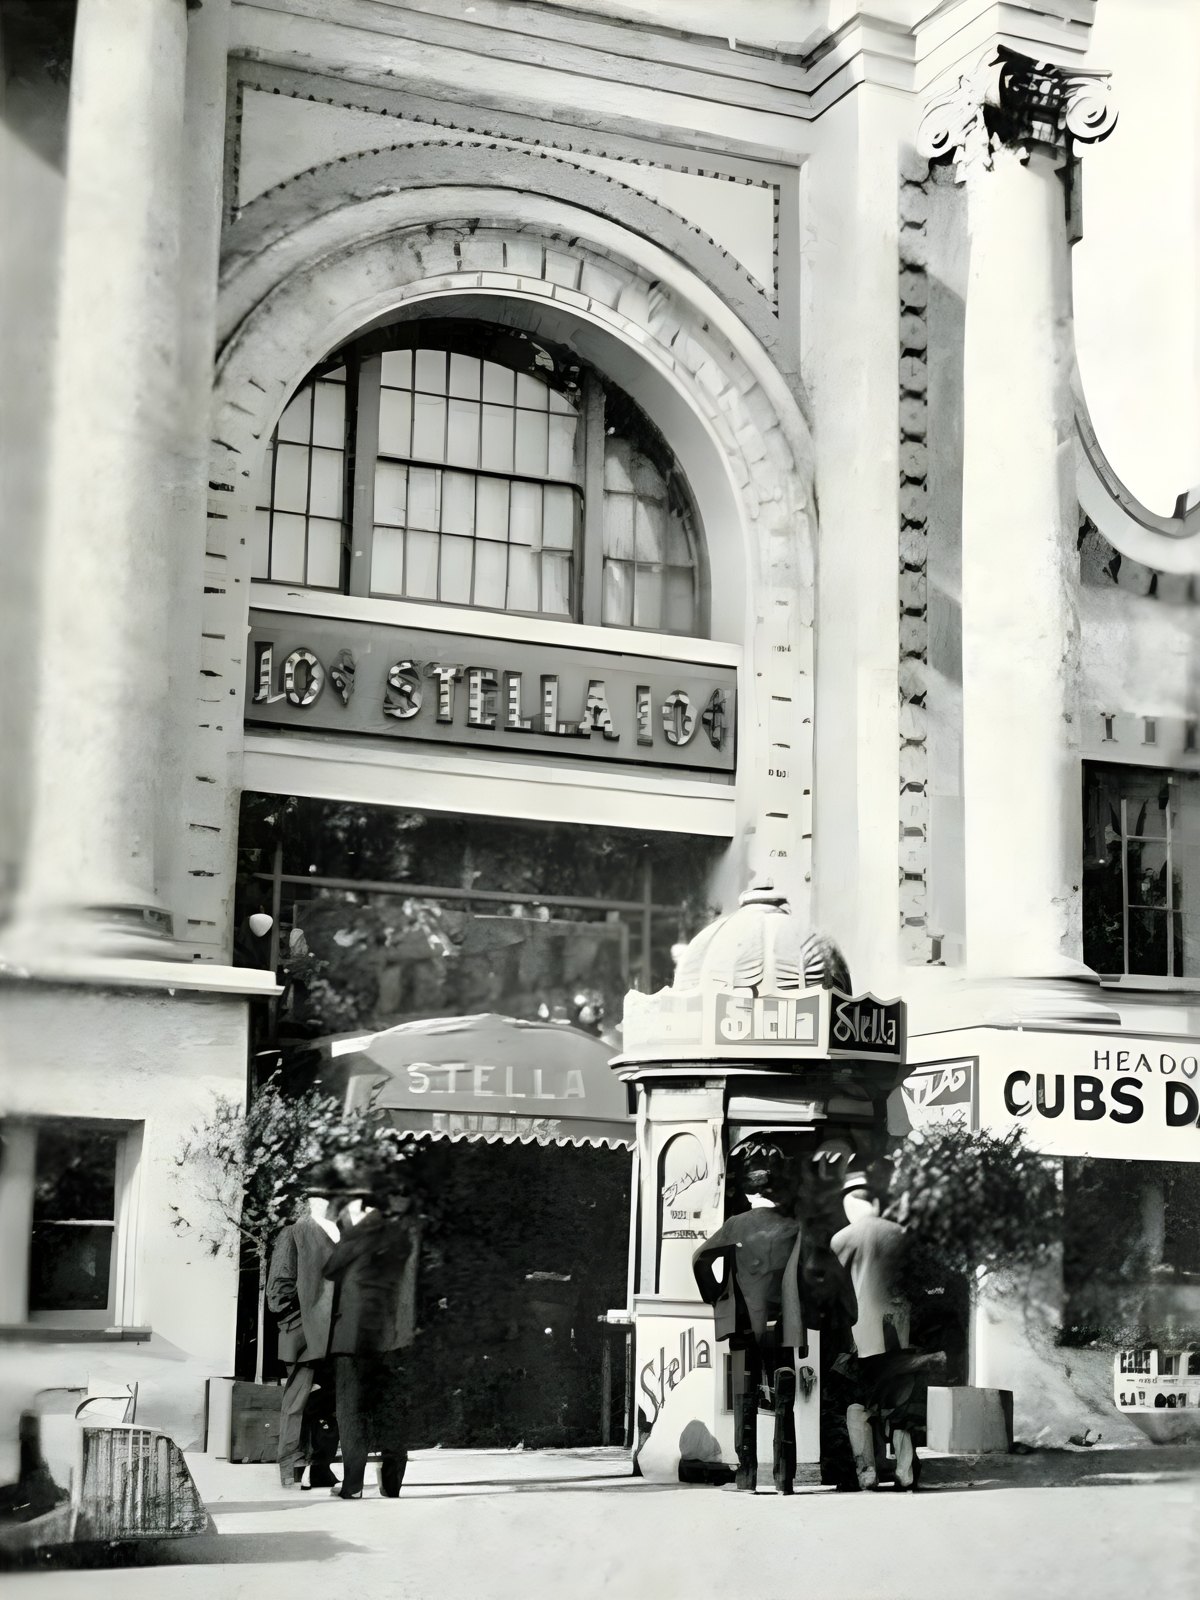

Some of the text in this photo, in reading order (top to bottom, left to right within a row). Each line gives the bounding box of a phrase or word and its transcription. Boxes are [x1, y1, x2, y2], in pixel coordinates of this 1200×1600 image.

[384, 660, 619, 742] STELLA
[407, 1063, 586, 1099] STELLA
[1004, 1070, 1144, 1124] CUBS
[1166, 1081, 1200, 1128] D
[638, 1327, 713, 1428] Stella
